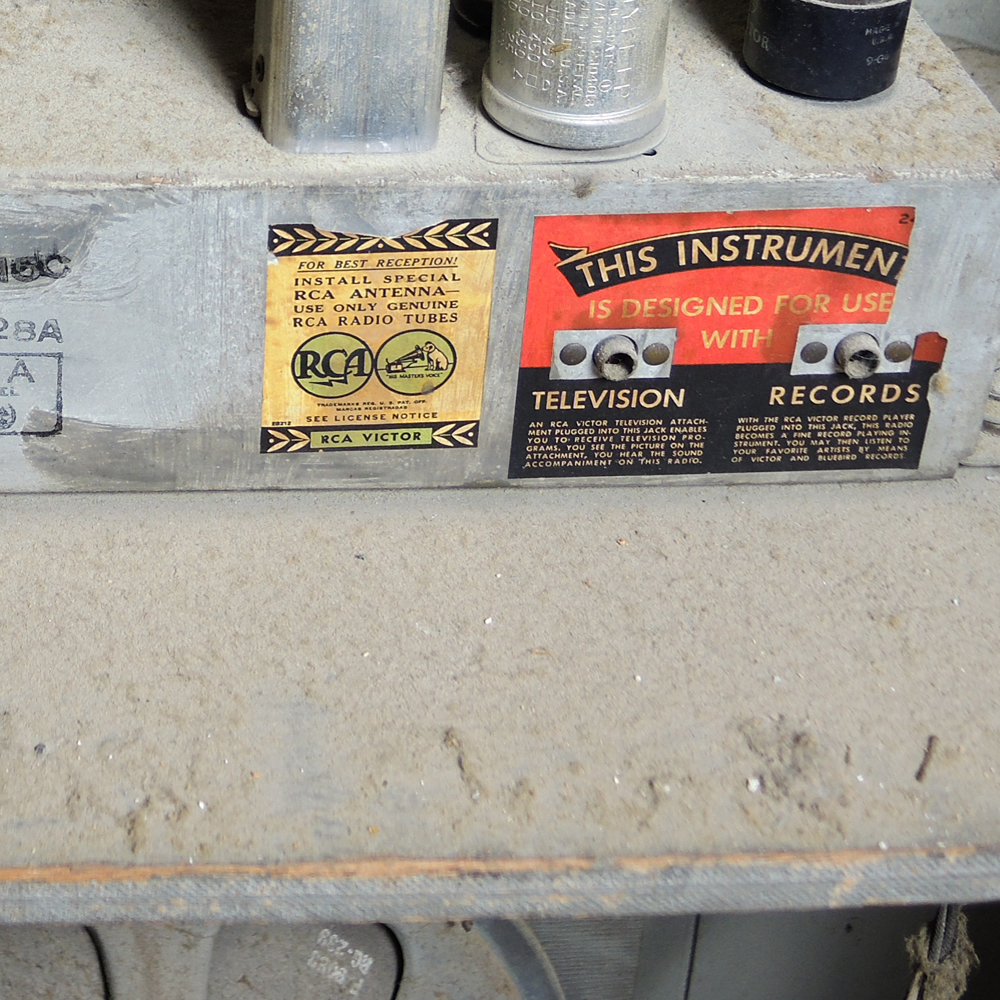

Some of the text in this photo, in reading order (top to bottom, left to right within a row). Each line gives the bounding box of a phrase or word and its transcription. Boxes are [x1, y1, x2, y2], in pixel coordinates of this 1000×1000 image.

[527, 32, 541, 63] 450
[298, 257, 458, 270] FOR BEST RECEPTION!
[576, 241, 658, 288] THIS
[294, 273, 461, 286] INSTALL SPECIAL
[294, 290, 335, 300] RCA
[588, 292, 894, 319] IS DESIGNED FOR USE
[294, 300, 459, 314] USE ONLY GENUINE
[292, 312, 458, 328] RCA RADIO TUBES
[700, 328, 774, 349] WITH
[6, 358, 36, 384] A
[297, 348, 370, 381] RCA
[532, 389, 686, 410] TELEVISION
[768, 384, 922, 406] RECORDS
[334, 414, 386, 422] LICENSE
[392, 412, 438, 420] NOTICE
[321, 432, 422, 444] RCA VICTOR
